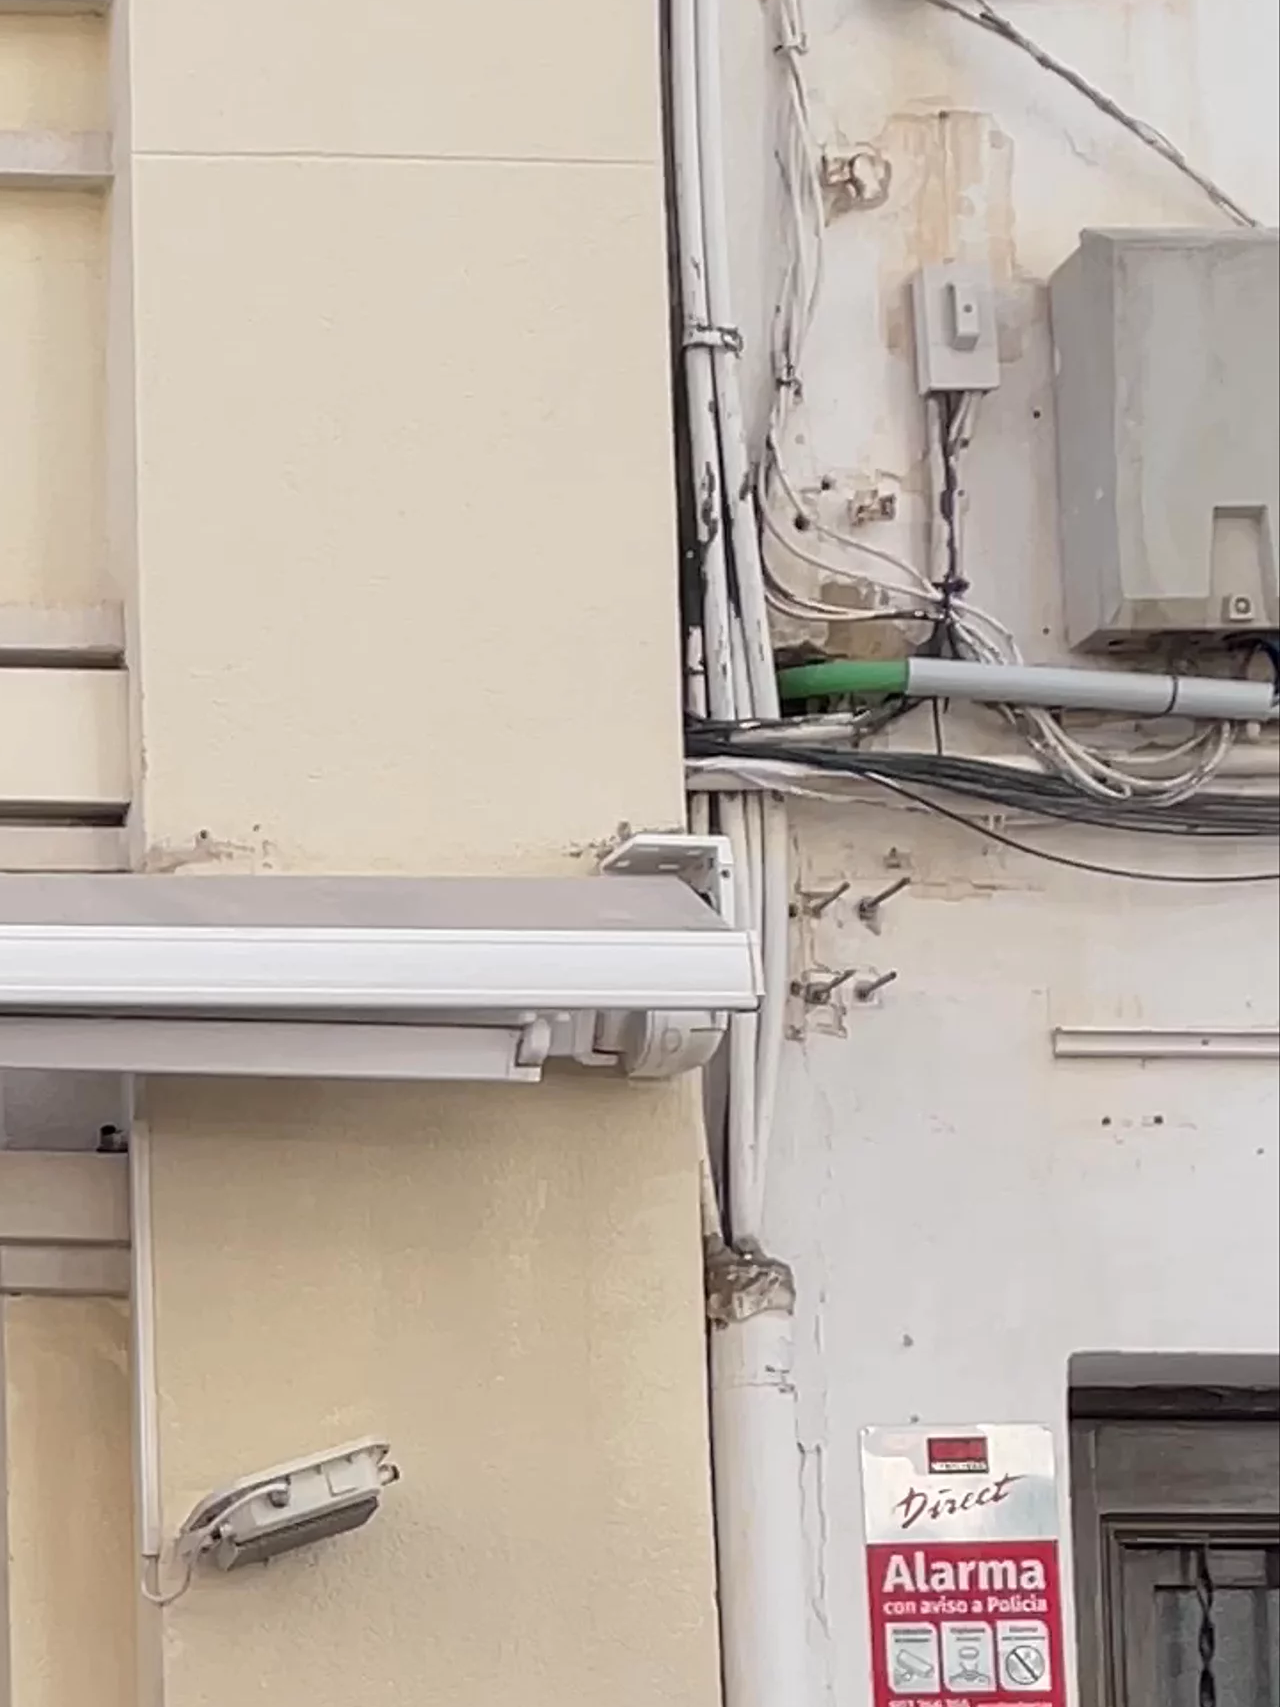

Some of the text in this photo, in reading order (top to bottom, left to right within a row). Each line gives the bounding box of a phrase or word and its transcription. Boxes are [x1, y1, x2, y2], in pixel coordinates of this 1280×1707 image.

[892, 1473, 1028, 1530] Direct
[882, 1551, 1046, 1592] Alarma
[882, 1600, 917, 1615] con
[920, 1596, 969, 1614] aviso
[971, 1598, 983, 1613] a
